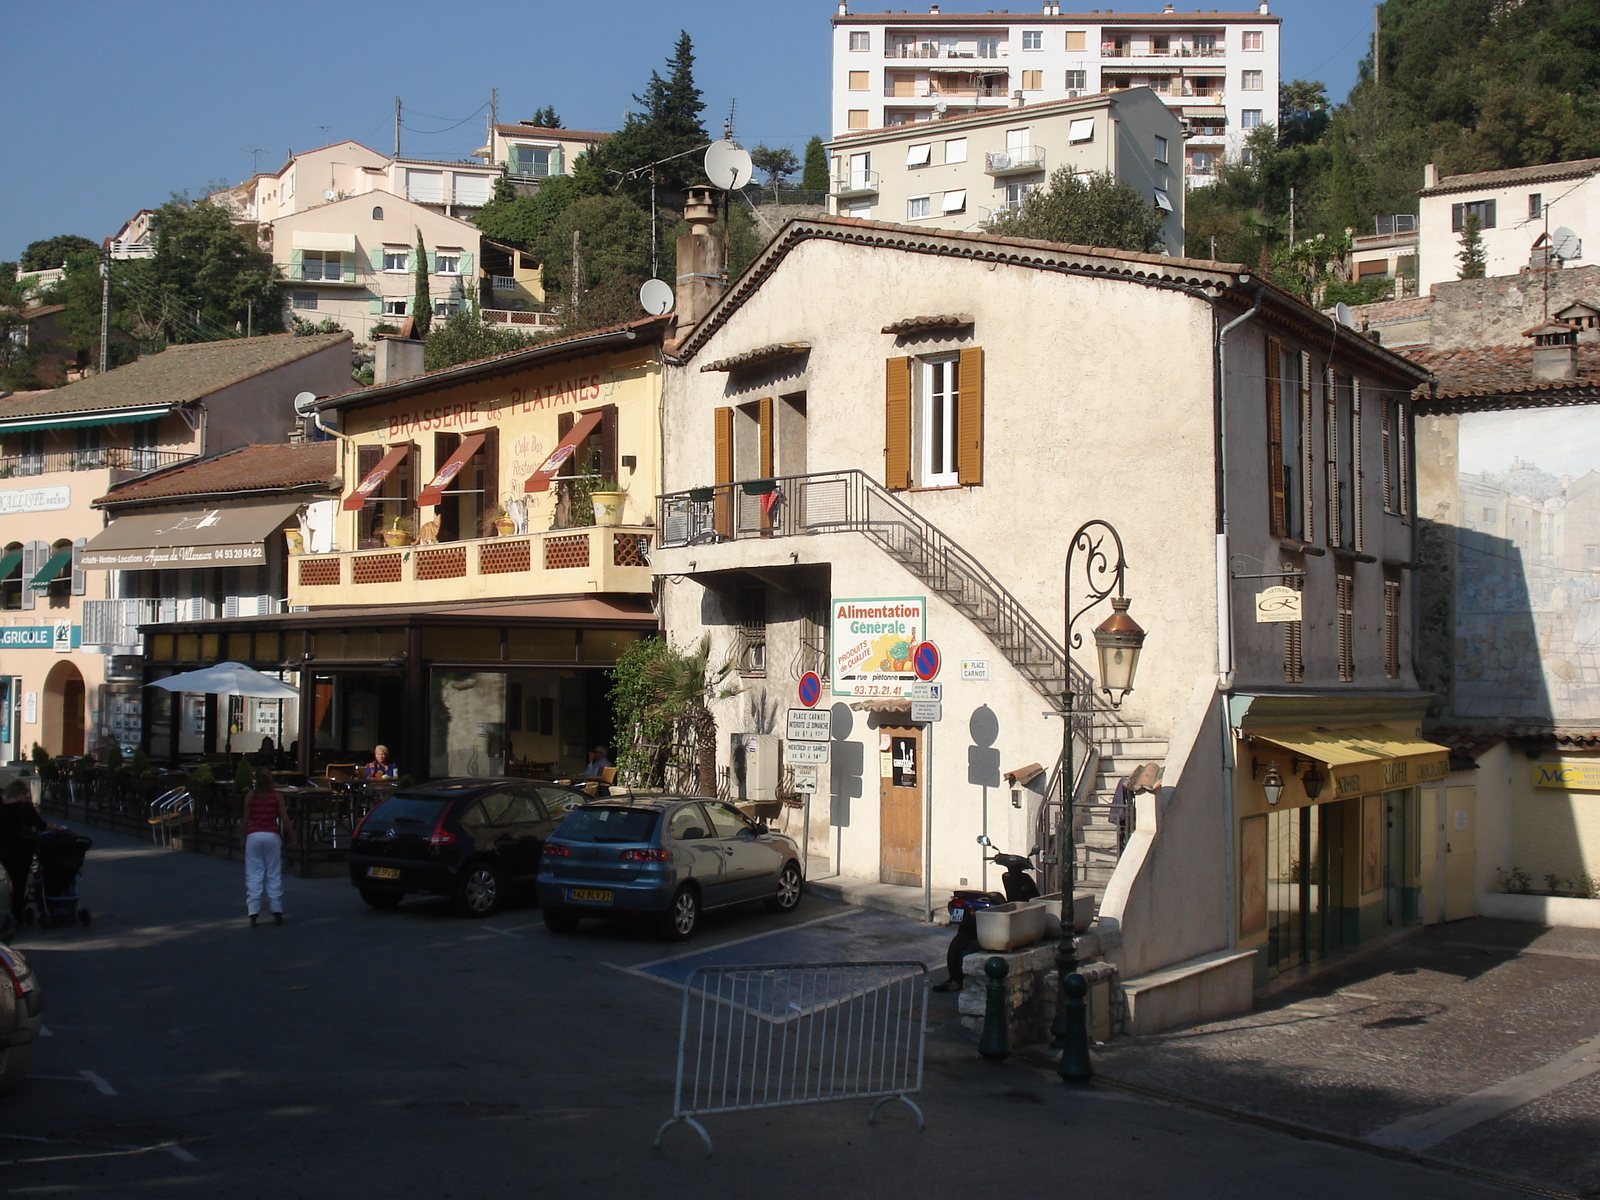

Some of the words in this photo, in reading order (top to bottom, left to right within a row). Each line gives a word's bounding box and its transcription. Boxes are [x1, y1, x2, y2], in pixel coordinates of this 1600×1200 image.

[389, 400, 478, 439] BRASSERIE
[487, 402, 502, 421] des
[510, 374, 600, 416] PLATANES
[515, 436, 530, 458] Café
[531, 435, 544, 455] Bar
[170, 547, 178, 561] de
[179, 547, 212, 560] Villeneuve
[215, 549, 223, 559] 04
[224, 549, 233, 559] 93
[233, 548, 242, 558] 20
[243, 548, 252, 558] 84
[252, 547, 262, 558] 22
[837, 604, 920, 619] Alimentation
[850, 620, 906, 634] Générale
[838, 640, 868, 664] PRODUITS
[840, 664, 847, 673] de
[854, 685, 902, 696] 93.73.21.41
[809, 713, 826, 721] CARNOT
[811, 722, 829, 730] DIMANCHE
[1383, 761, 1408, 785] RIGHI
[573, 890, 585, 898] 142
[602, 892, 610, 900] 31
